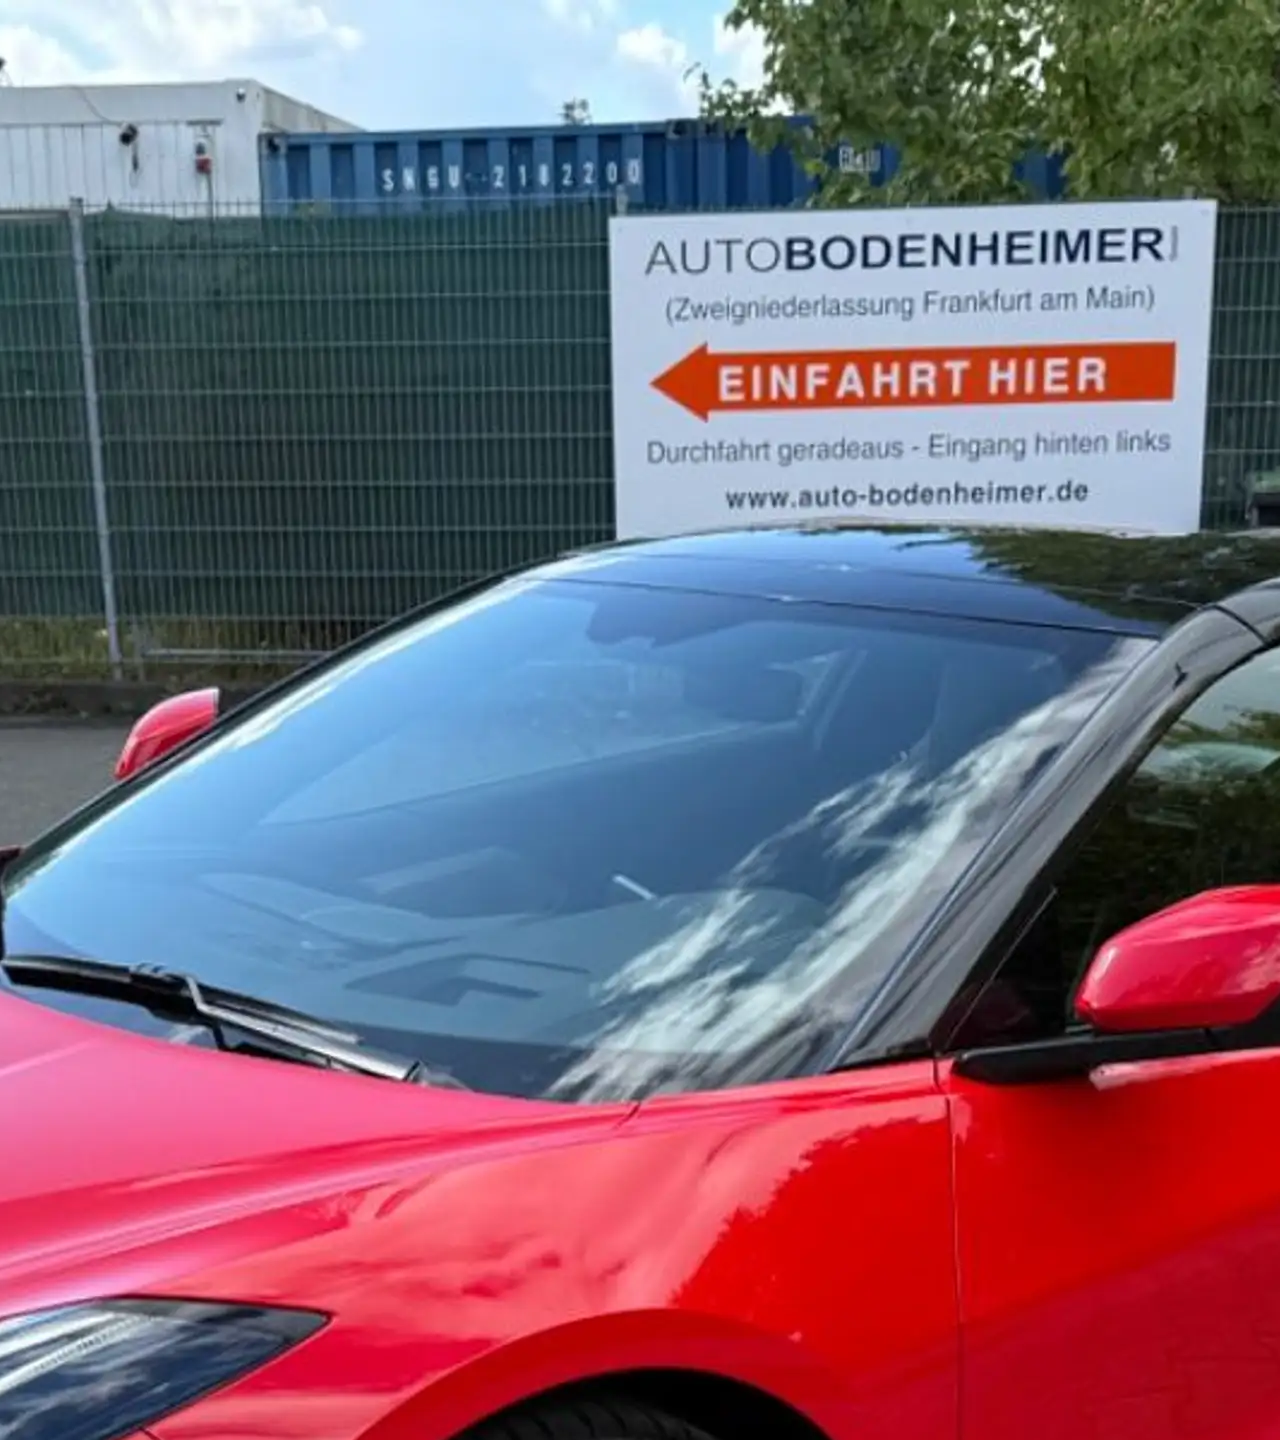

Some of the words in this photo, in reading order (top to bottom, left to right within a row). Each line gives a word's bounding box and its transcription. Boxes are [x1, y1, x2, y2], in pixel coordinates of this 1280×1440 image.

[644, 227, 1165, 275] AUTOBODENHEIMER
[665, 295, 915, 327] (Zweigniederlassung
[922, 288, 1032, 314] Frankfurt
[1039, 292, 1078, 311] am
[1086, 285, 1156, 312] Main)
[719, 360, 971, 401] EINFAHRT
[988, 357, 1107, 396] HIER
[647, 438, 770, 464] Durchfahrt
[777, 437, 905, 467] geradeaus
[928, 432, 1027, 462] Eingang
[1035, 431, 1109, 456] hinten
[1116, 429, 1172, 452] links
[725, 479, 1089, 509] www.auto-bodenheimer.de
